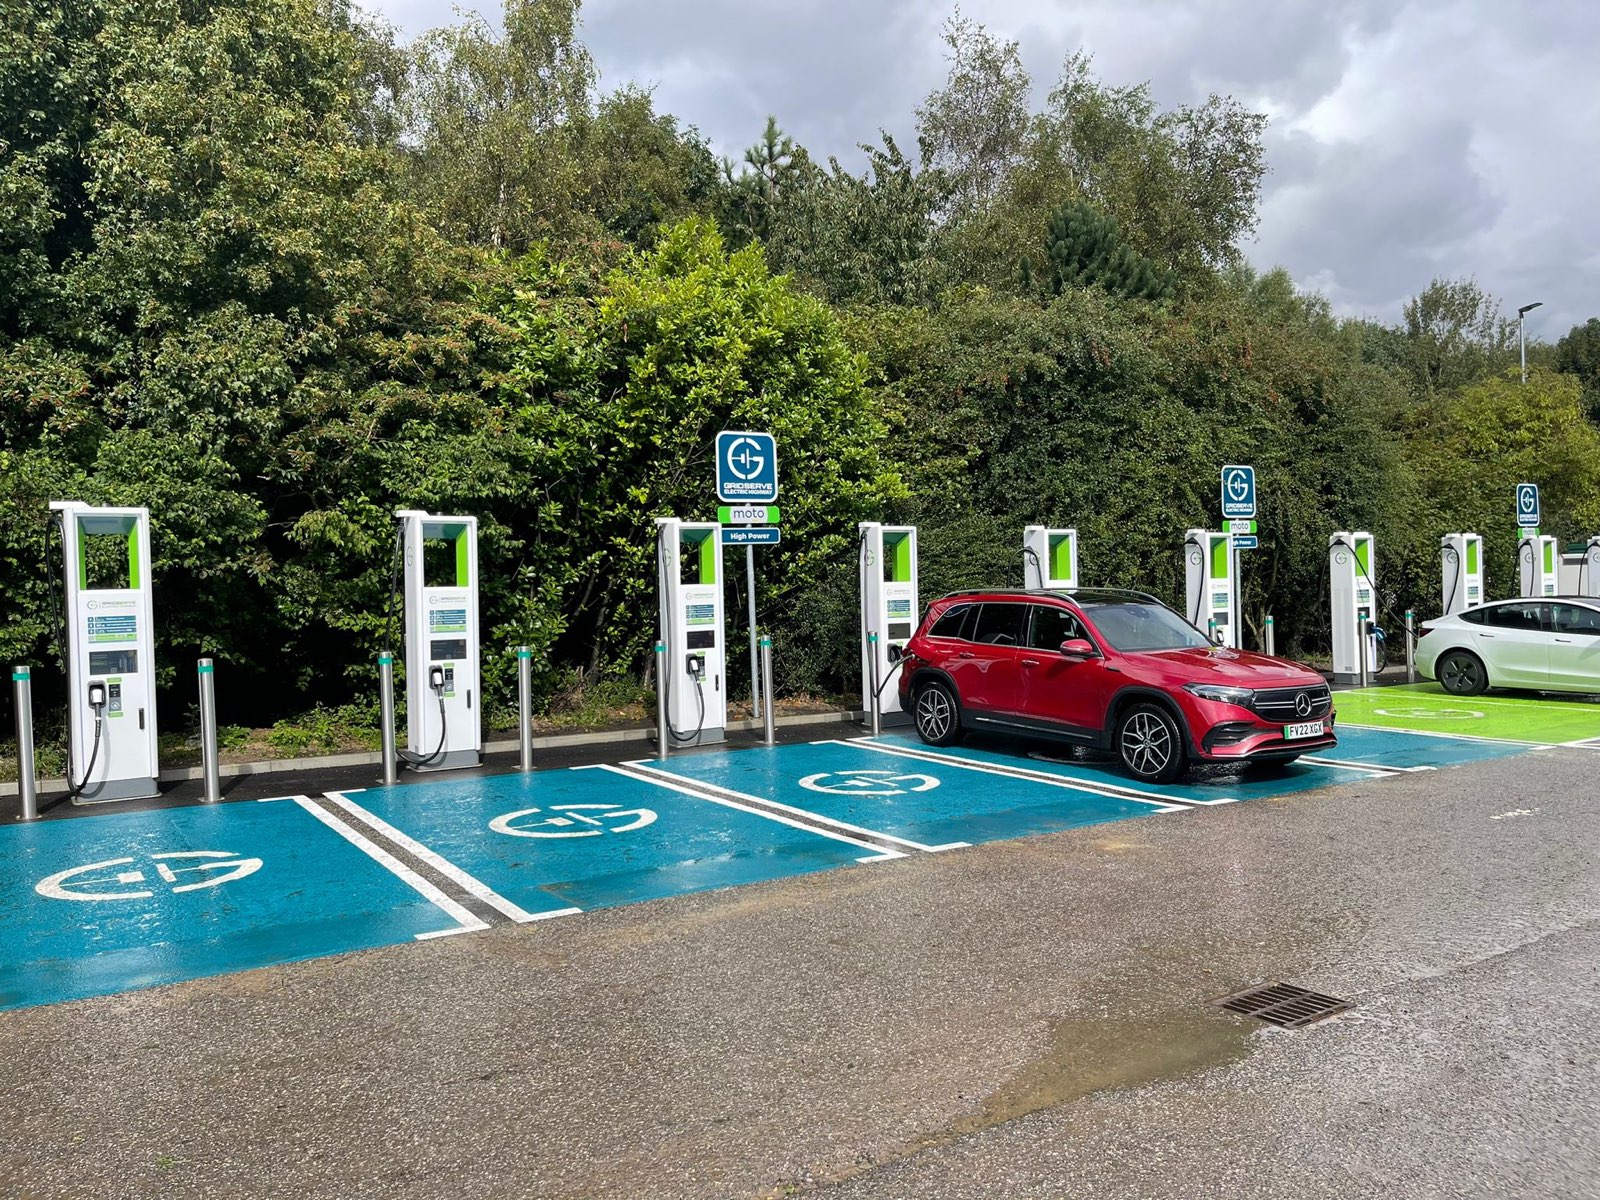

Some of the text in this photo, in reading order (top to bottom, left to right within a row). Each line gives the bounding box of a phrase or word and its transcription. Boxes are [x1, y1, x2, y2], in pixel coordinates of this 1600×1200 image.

[723, 482, 773, 490] GRIDSERVE
[733, 508, 765, 519] moto
[1231, 522, 1249, 530] moto
[730, 533, 747, 541] High
[1290, 722, 1323, 737] FV22 XGX
